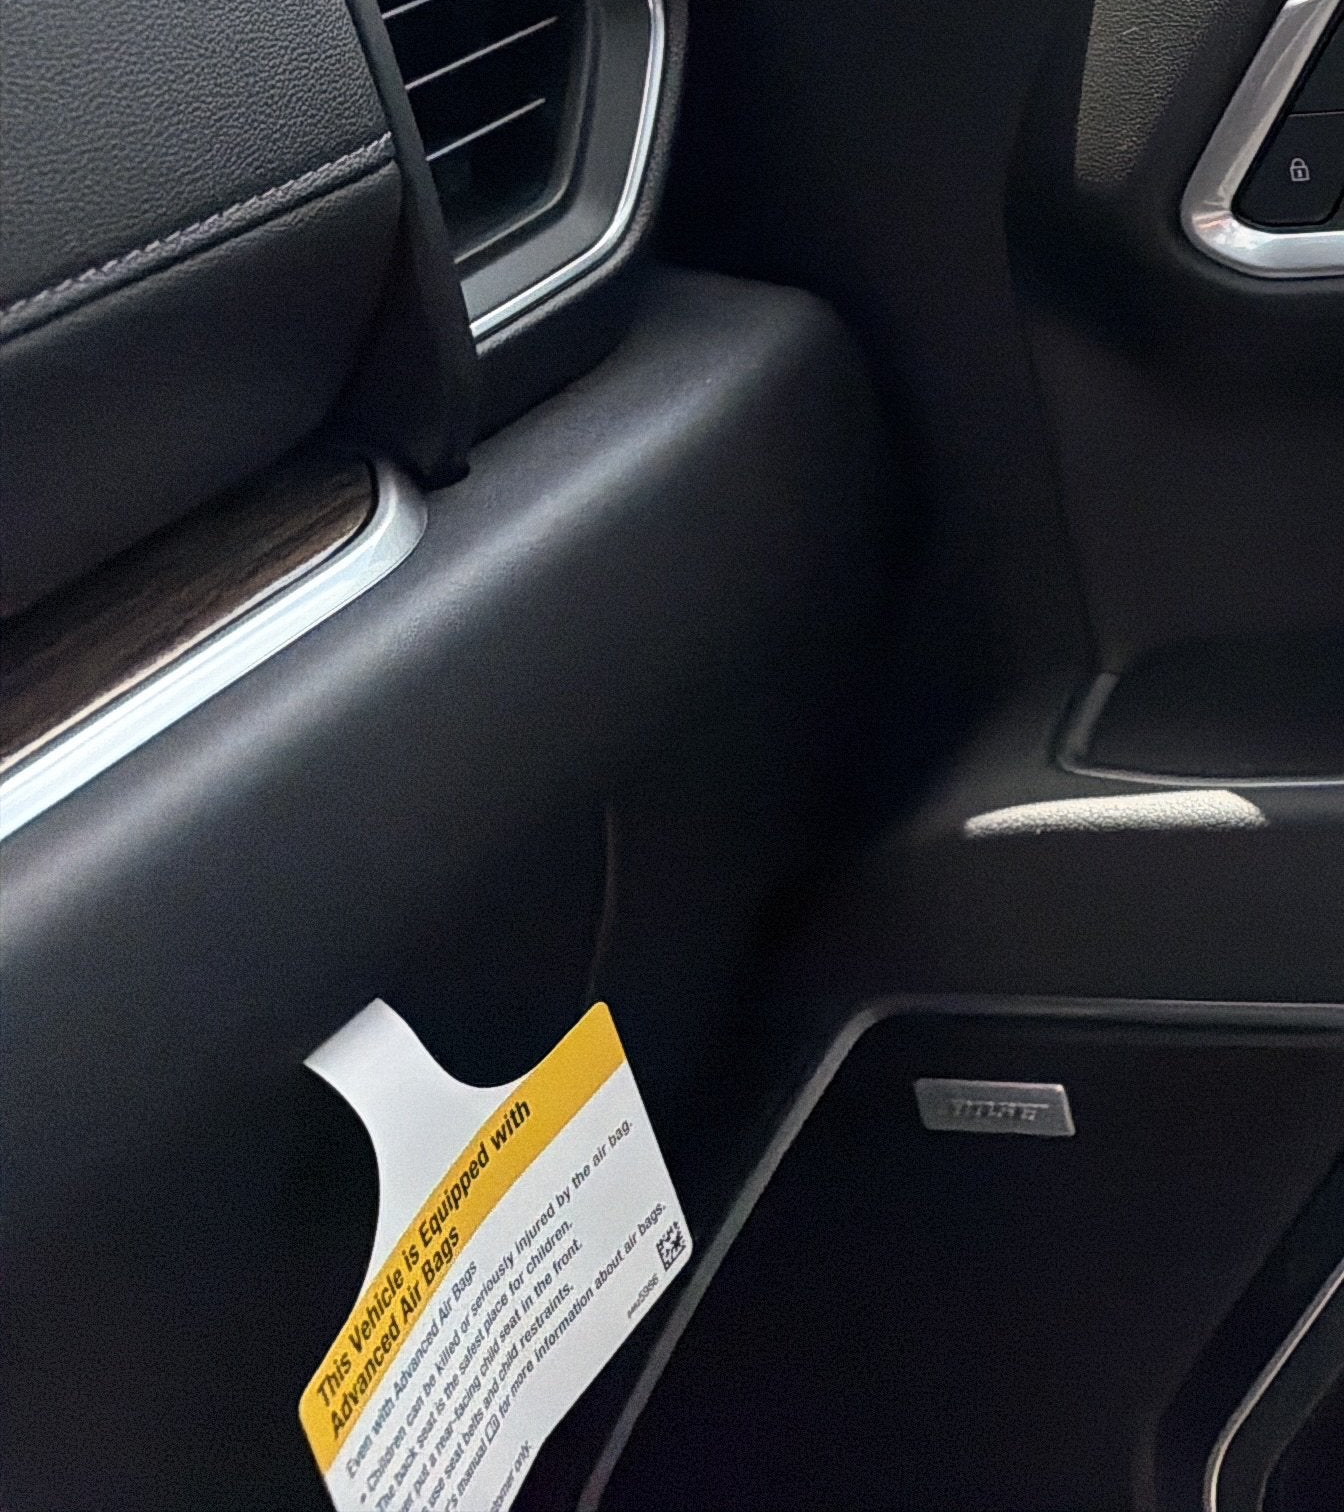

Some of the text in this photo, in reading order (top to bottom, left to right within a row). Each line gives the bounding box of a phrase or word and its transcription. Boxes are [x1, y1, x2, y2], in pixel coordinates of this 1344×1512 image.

[317, 1100, 531, 1407] This Vehicle is Equipped with
[331, 1226, 459, 1440] Advanced Air Bags
[367, 1119, 633, 1492] Children can be killed or seriously injured by the air bag.
[417, 1411, 437, 1448] seat
[434, 1397, 446, 1416] is
[443, 1373, 460, 1400] the
[459, 1328, 485, 1376] safest
[483, 1293, 508, 1338] place
[508, 1271, 525, 1295] for
[526, 1220, 573, 1275] children.
[457, 1438, 488, 1497] manual
[499, 1394, 511, 1418] for
[511, 1360, 534, 1397] more
[534, 1287, 594, 1363] information
[594, 1249, 625, 1290] about
[623, 1232, 638, 1254] air
[637, 1203, 666, 1237] bags.
[480, 1338, 500, 1377] child
[500, 1309, 521, 1343] seat
[521, 1295, 533, 1314] in
[534, 1272, 553, 1298] the
[553, 1238, 583, 1275] front.
[346, 1261, 477, 1479] Even with Advanced Air Bags
[444, 1442, 464, 1479] seat
[462, 1406, 484, 1446] belts
[483, 1377, 499, 1410] and
[499, 1343, 518, 1382] child
[520, 1283, 574, 1349] restraints.
